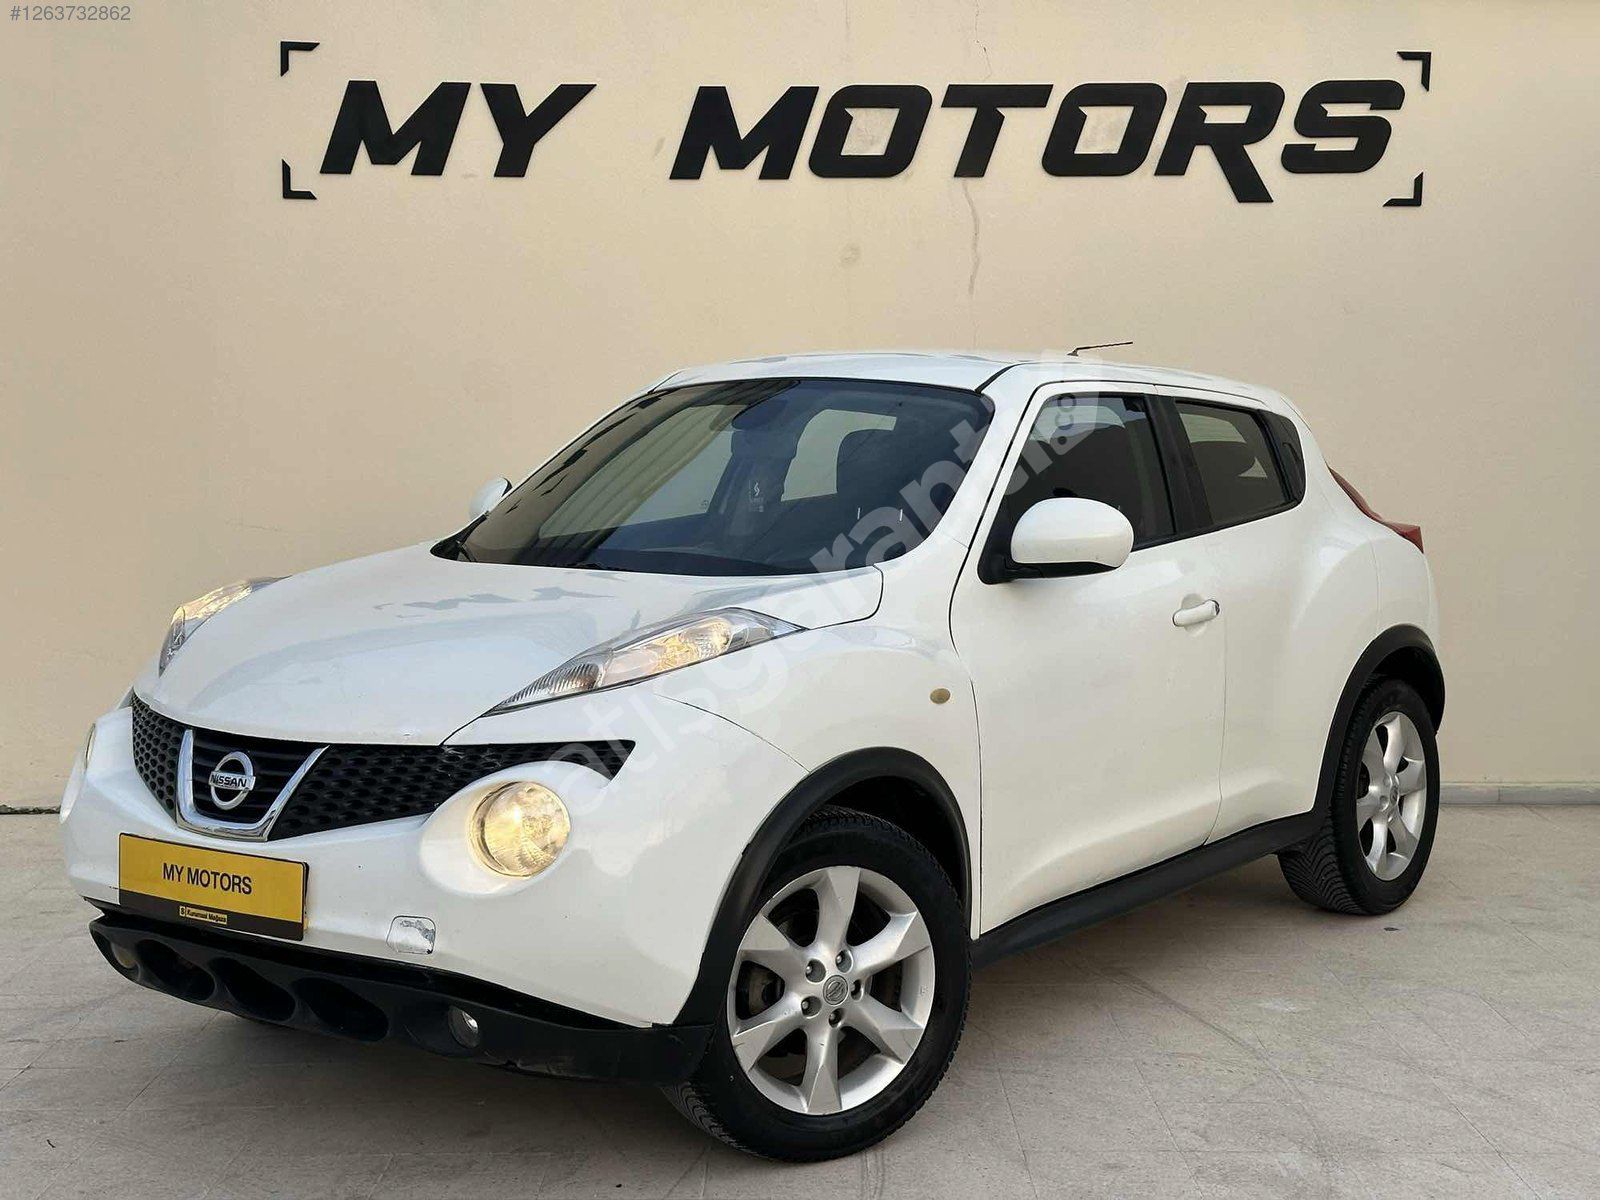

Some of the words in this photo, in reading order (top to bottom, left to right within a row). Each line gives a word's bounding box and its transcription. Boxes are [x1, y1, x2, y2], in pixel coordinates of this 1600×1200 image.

[320, 81, 597, 178] MY
[670, 80, 1406, 204] MOTORS
[210, 774, 248, 788] NISSAN
[162, 862, 184, 882] MY
[187, 866, 253, 895] MOTORS
